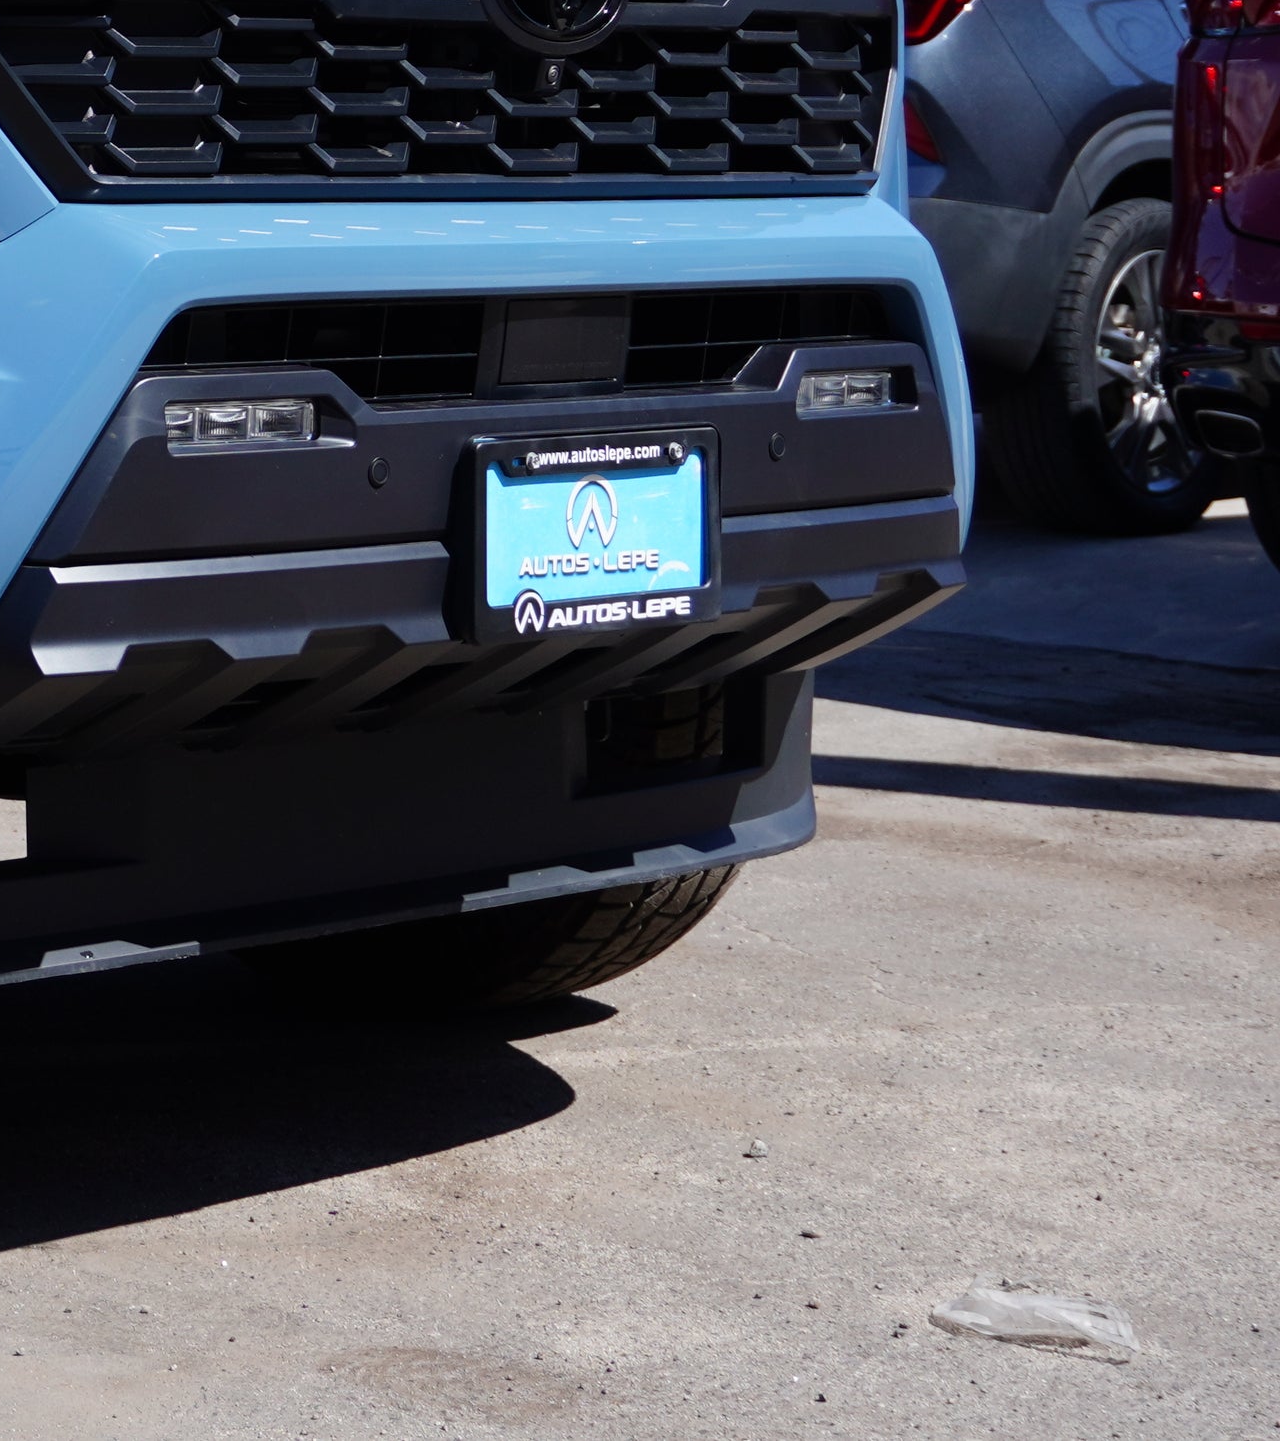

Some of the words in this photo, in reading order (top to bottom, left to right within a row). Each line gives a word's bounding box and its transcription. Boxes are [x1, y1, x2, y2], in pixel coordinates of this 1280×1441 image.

[539, 444, 661, 465] www.autoslepe.com
[519, 553, 590, 577] AUTOS
[603, 549, 659, 572] LEPE
